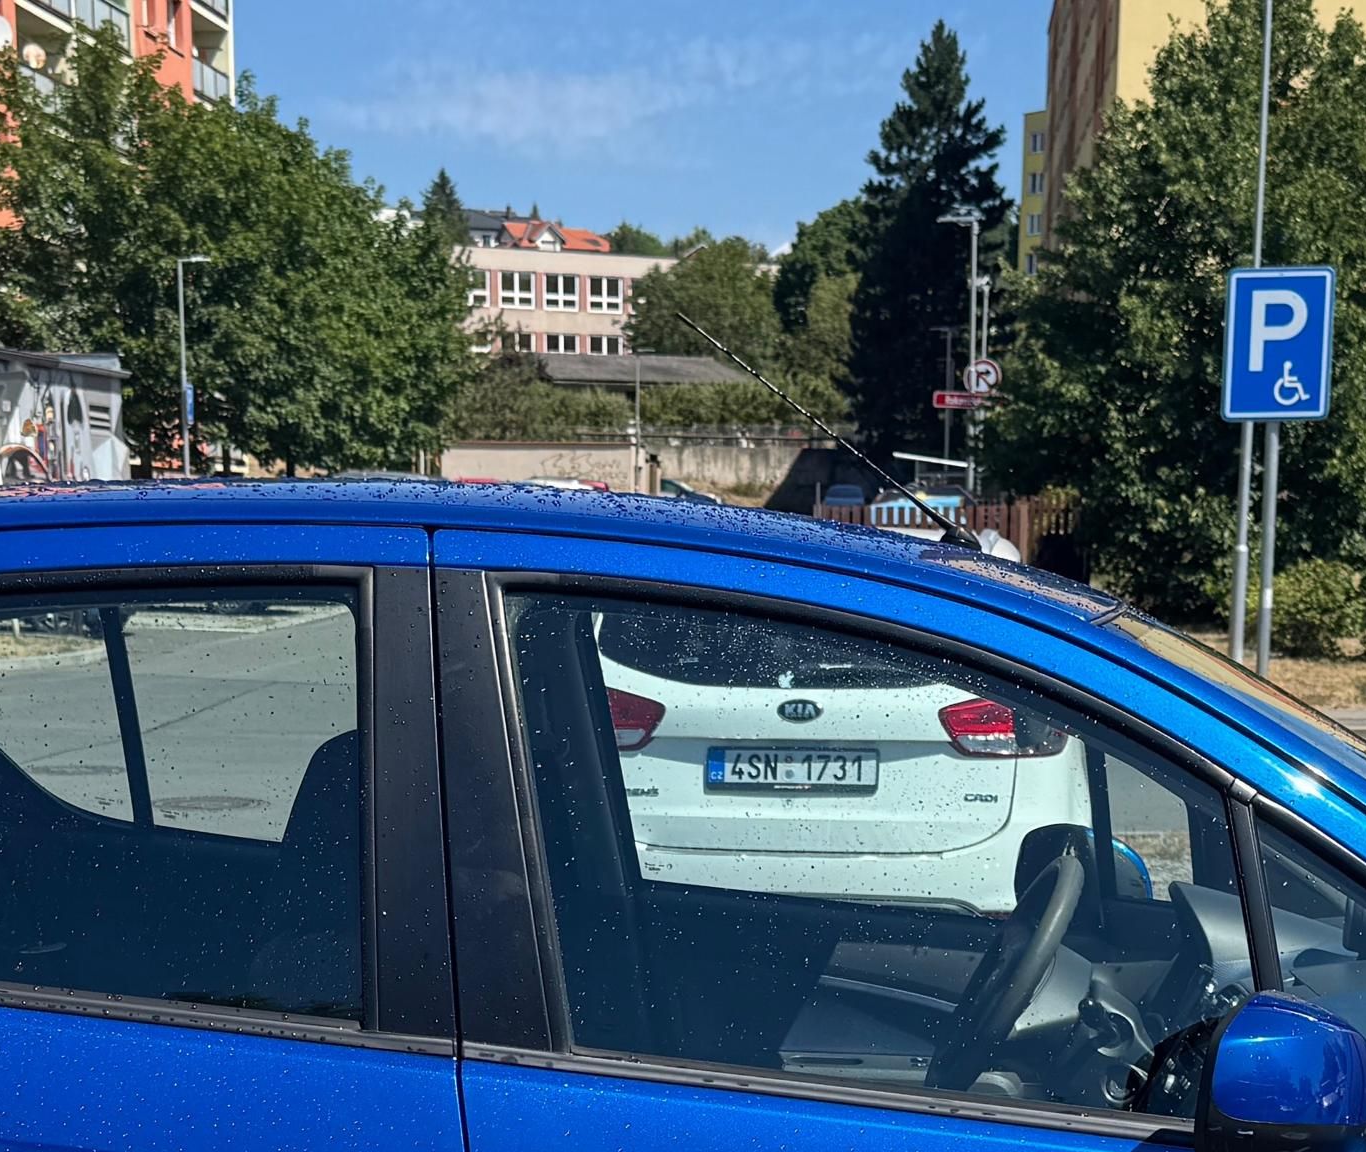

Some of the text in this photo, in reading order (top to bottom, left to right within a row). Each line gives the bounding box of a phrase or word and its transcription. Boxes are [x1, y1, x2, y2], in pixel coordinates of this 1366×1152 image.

[1248, 290, 1308, 372] P
[785, 703, 816, 718] KIA
[710, 772, 723, 780] CZ
[731, 753, 864, 782] 4SN 1731
